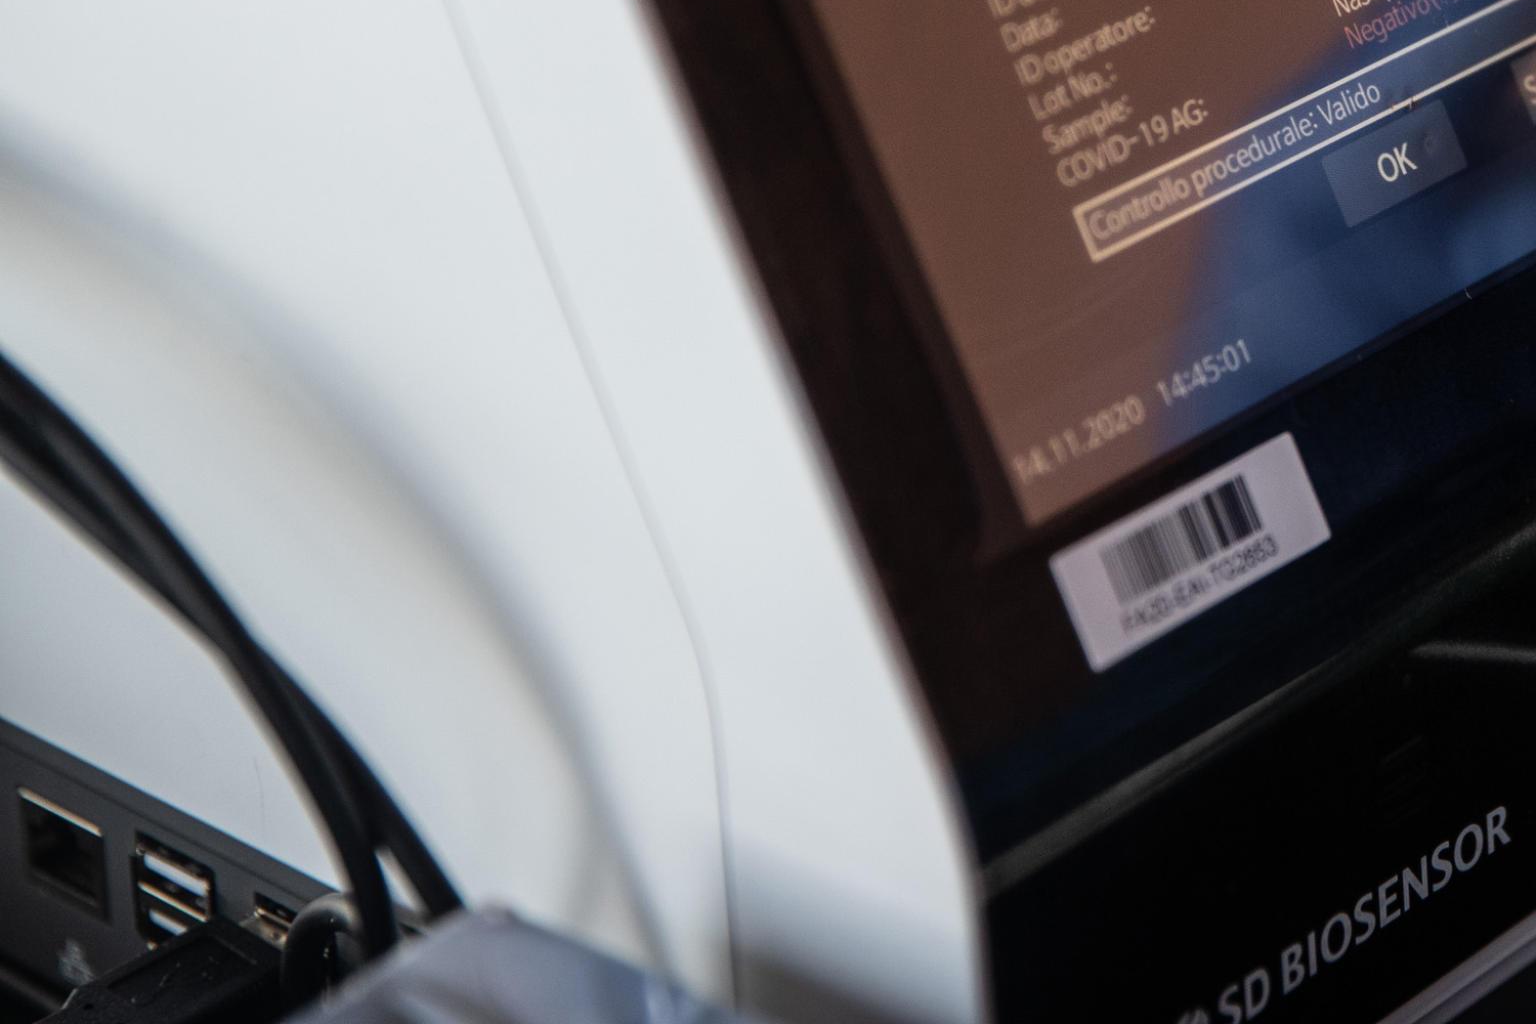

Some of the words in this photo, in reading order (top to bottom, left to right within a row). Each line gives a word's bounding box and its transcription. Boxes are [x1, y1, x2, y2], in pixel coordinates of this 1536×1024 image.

[1043, 5, 1156, 75] operatore:
[1027, 85, 1069, 121] Lot
[1042, 94, 1134, 155] Sample:
[1171, 98, 1209, 134] AG:
[1089, 175, 1191, 240] Controllo
[1191, 111, 1318, 198] procedurale:
[1316, 82, 1381, 126] Valido
[1377, 141, 1418, 182] OK
[1013, 394, 1146, 485] 14.11.2020
[1156, 338, 1252, 406] 14:45:01
[1218, 967, 1270, 1024] SD
[1281, 805, 1512, 995] BIOSENSOR
